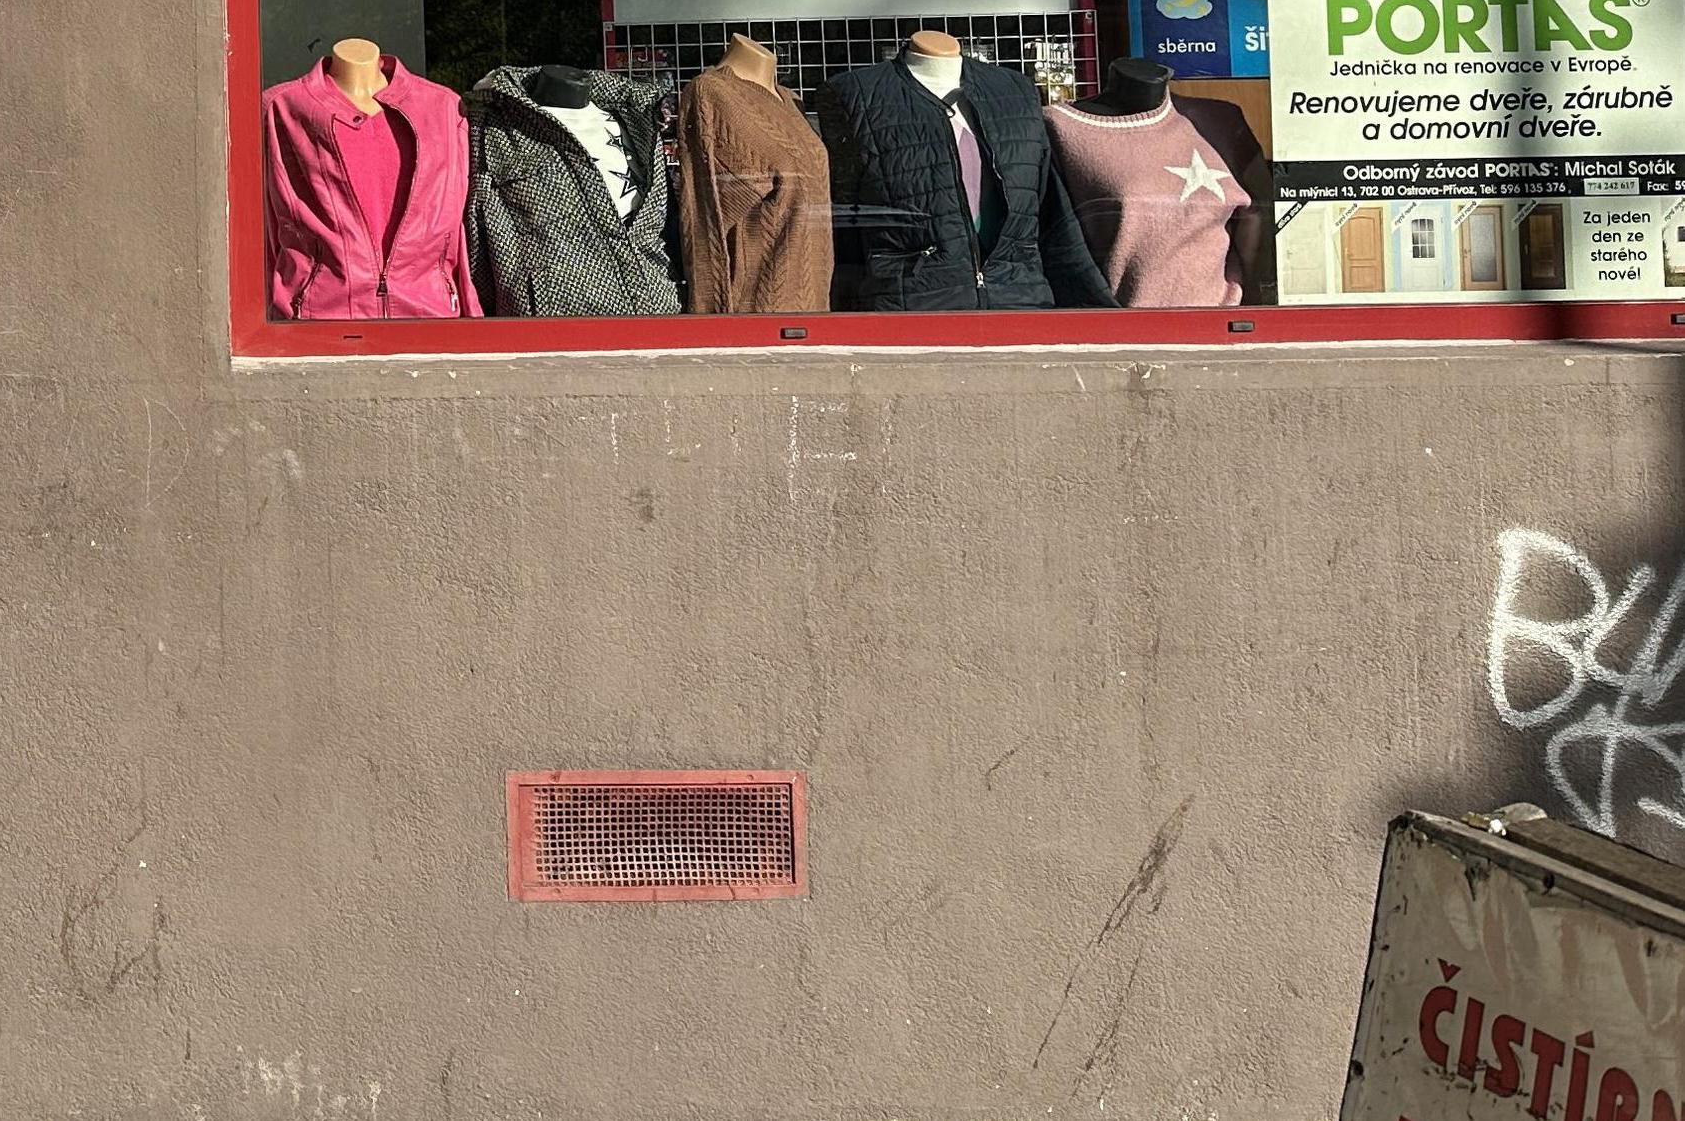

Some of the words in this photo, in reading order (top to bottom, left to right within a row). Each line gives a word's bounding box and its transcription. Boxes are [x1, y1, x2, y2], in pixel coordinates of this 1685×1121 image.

[1158, 38, 1216, 53] sběrna
[1329, 58, 1416, 77] Jednička
[1424, 61, 1447, 75] na
[1454, 59, 1544, 74] renovace
[1550, 60, 1561, 72] v
[1568, 55, 1637, 75] Evropě.
[1289, 89, 1460, 118] Renovujeme
[1470, 87, 1552, 113] dveře,
[1563, 85, 1673, 110] zárubně
[1362, 122, 1380, 140] a
[1390, 115, 1512, 141] domovní
[1518, 114, 1602, 138] dveře.
[1343, 163, 1420, 182] Odborný
[1426, 163, 1479, 179] závod
[1565, 161, 1622, 176] Michal
[1280, 187, 1297, 198] Na
[1341, 186, 1357, 198] 13,
[1360, 185, 1379, 197] 702
[1382, 185, 1395, 196] 00
[1398, 183, 1478, 197] Ostrava-Přívoz,
[1500, 184, 1521, 194] 596
[1524, 183, 1543, 194] 135
[1583, 211, 1602, 224] Za
[1607, 211, 1651, 226] jeden
[1592, 230, 1621, 242] den
[1627, 232, 1645, 241] ze
[1590, 247, 1647, 261] starého
[1598, 266, 1641, 280] nové!
